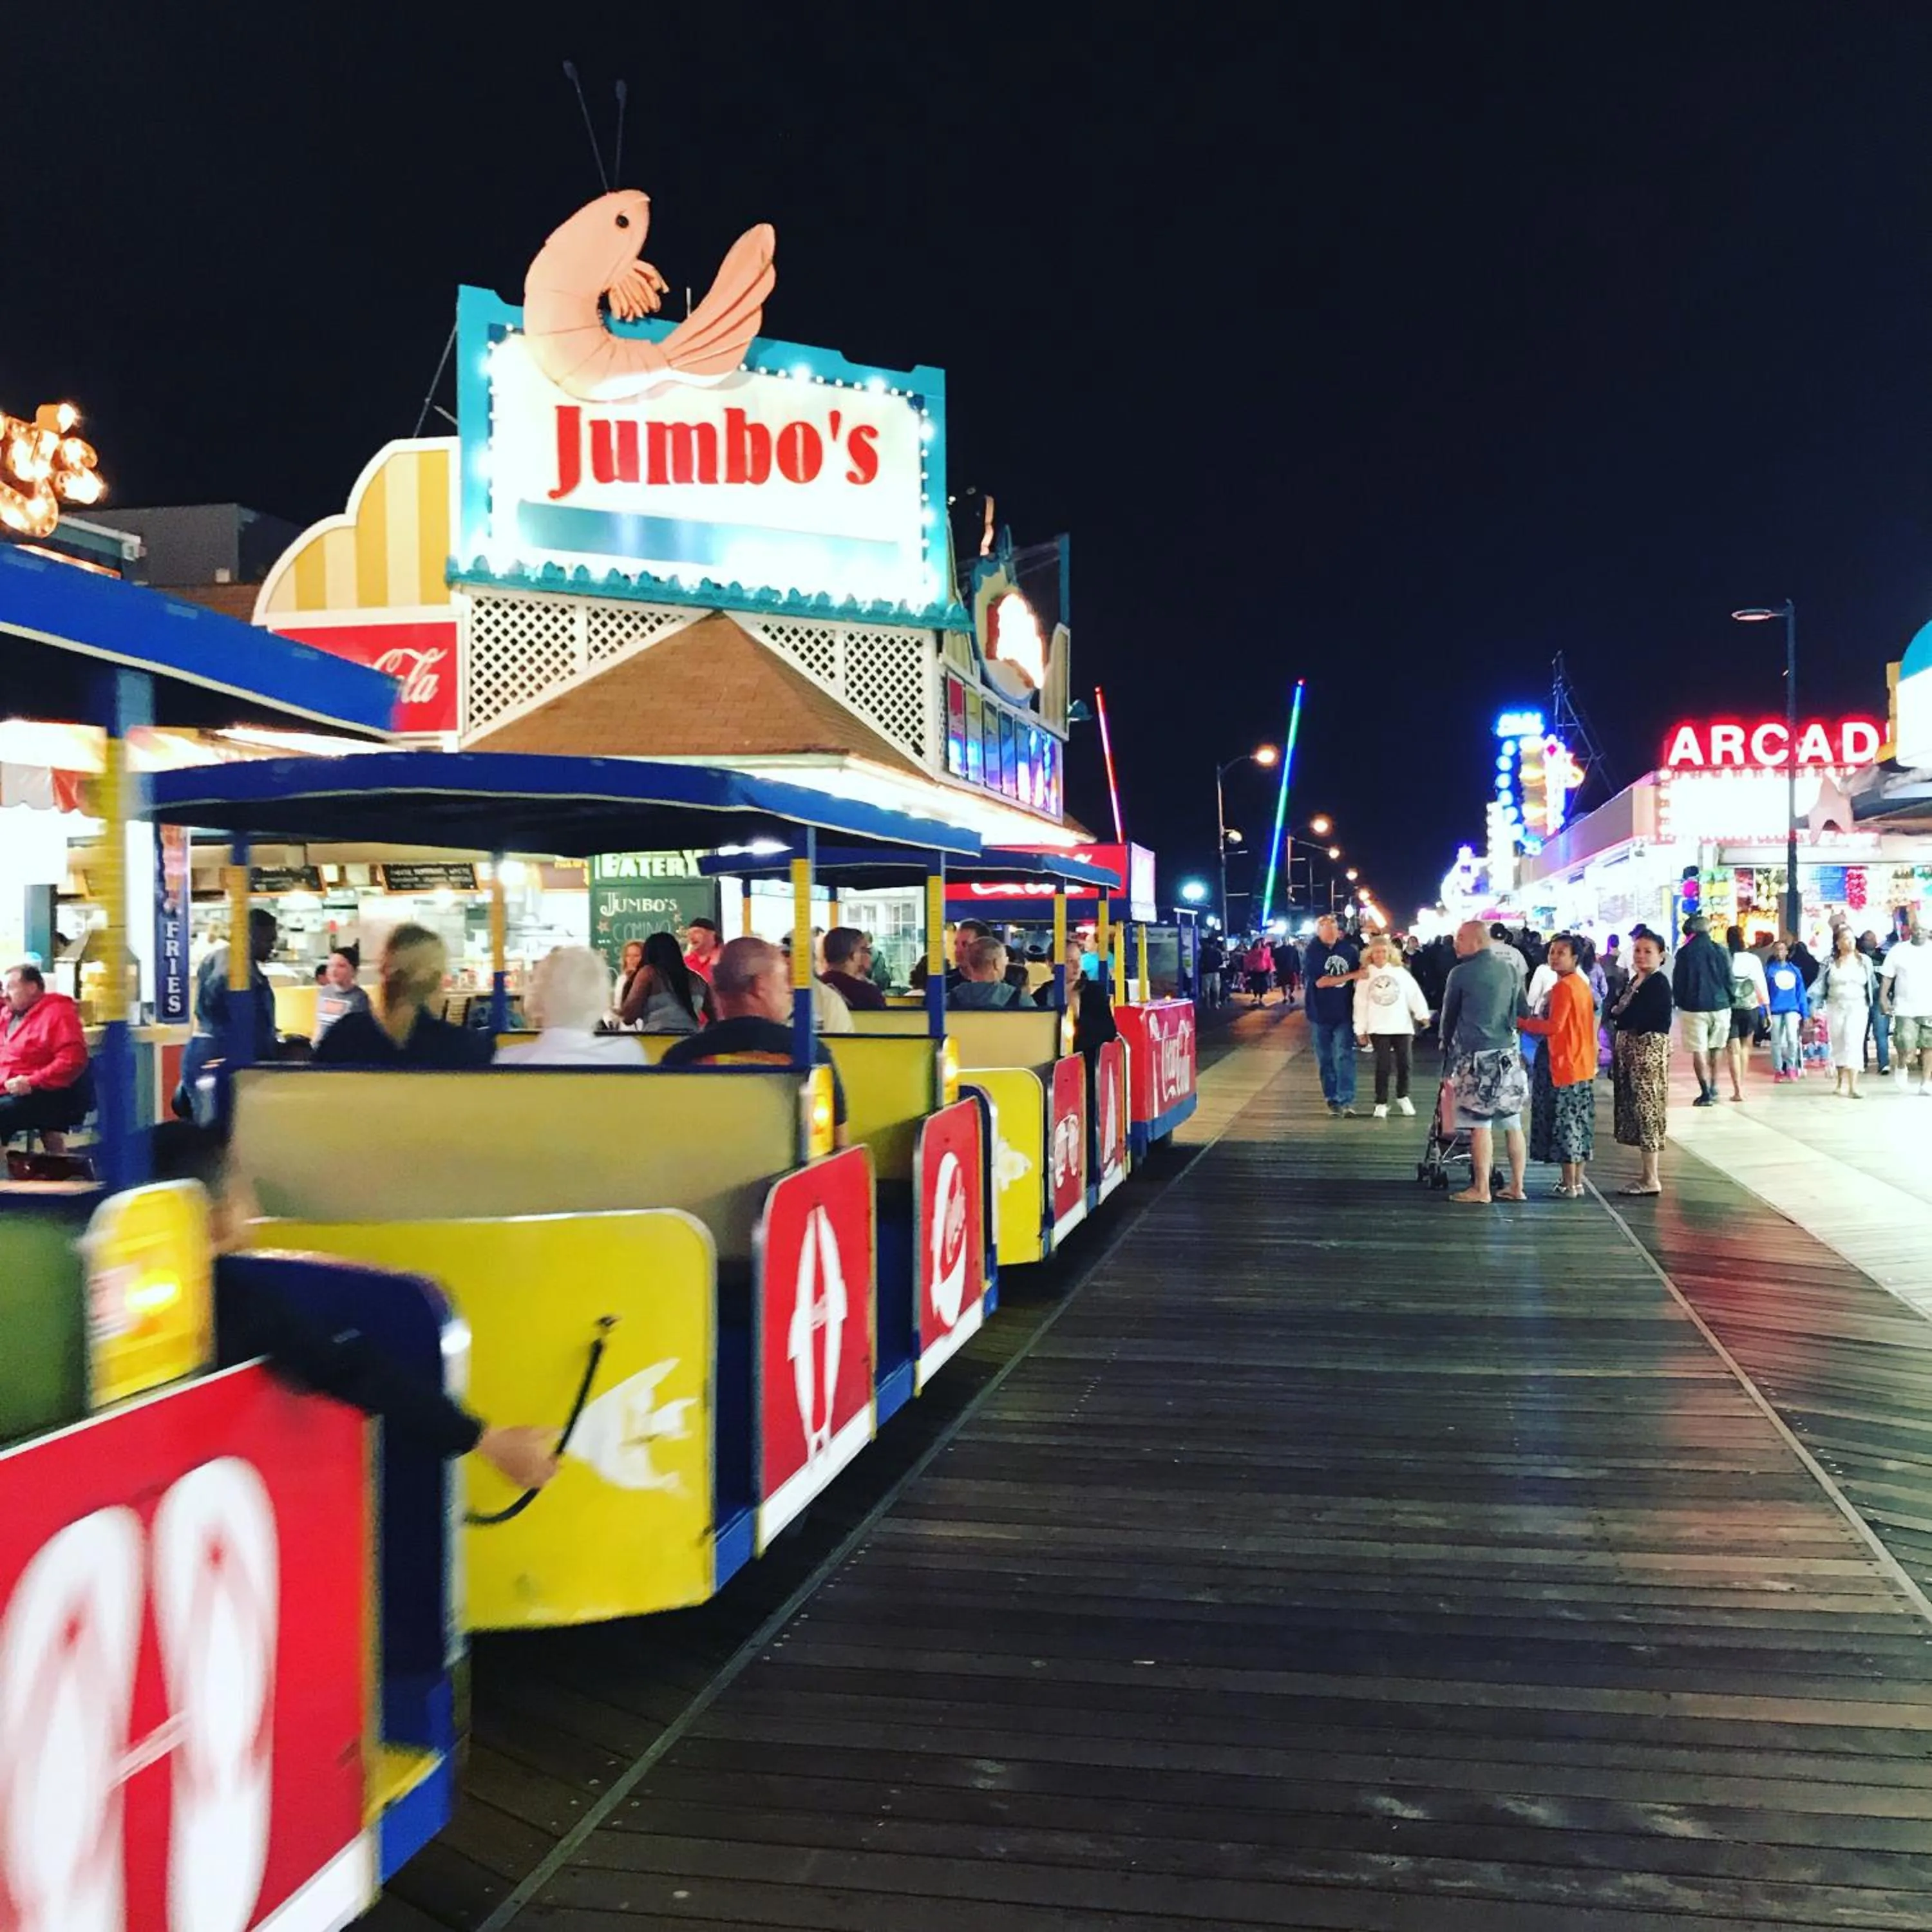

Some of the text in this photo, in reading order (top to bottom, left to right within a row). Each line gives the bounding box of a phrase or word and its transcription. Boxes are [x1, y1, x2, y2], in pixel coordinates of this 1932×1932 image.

[548, 404, 879, 501] Jumbo's
[373, 647, 449, 703] Cla
[1667, 722, 1889, 766] ARCAD
[165, 921, 182, 1013] FRIES
